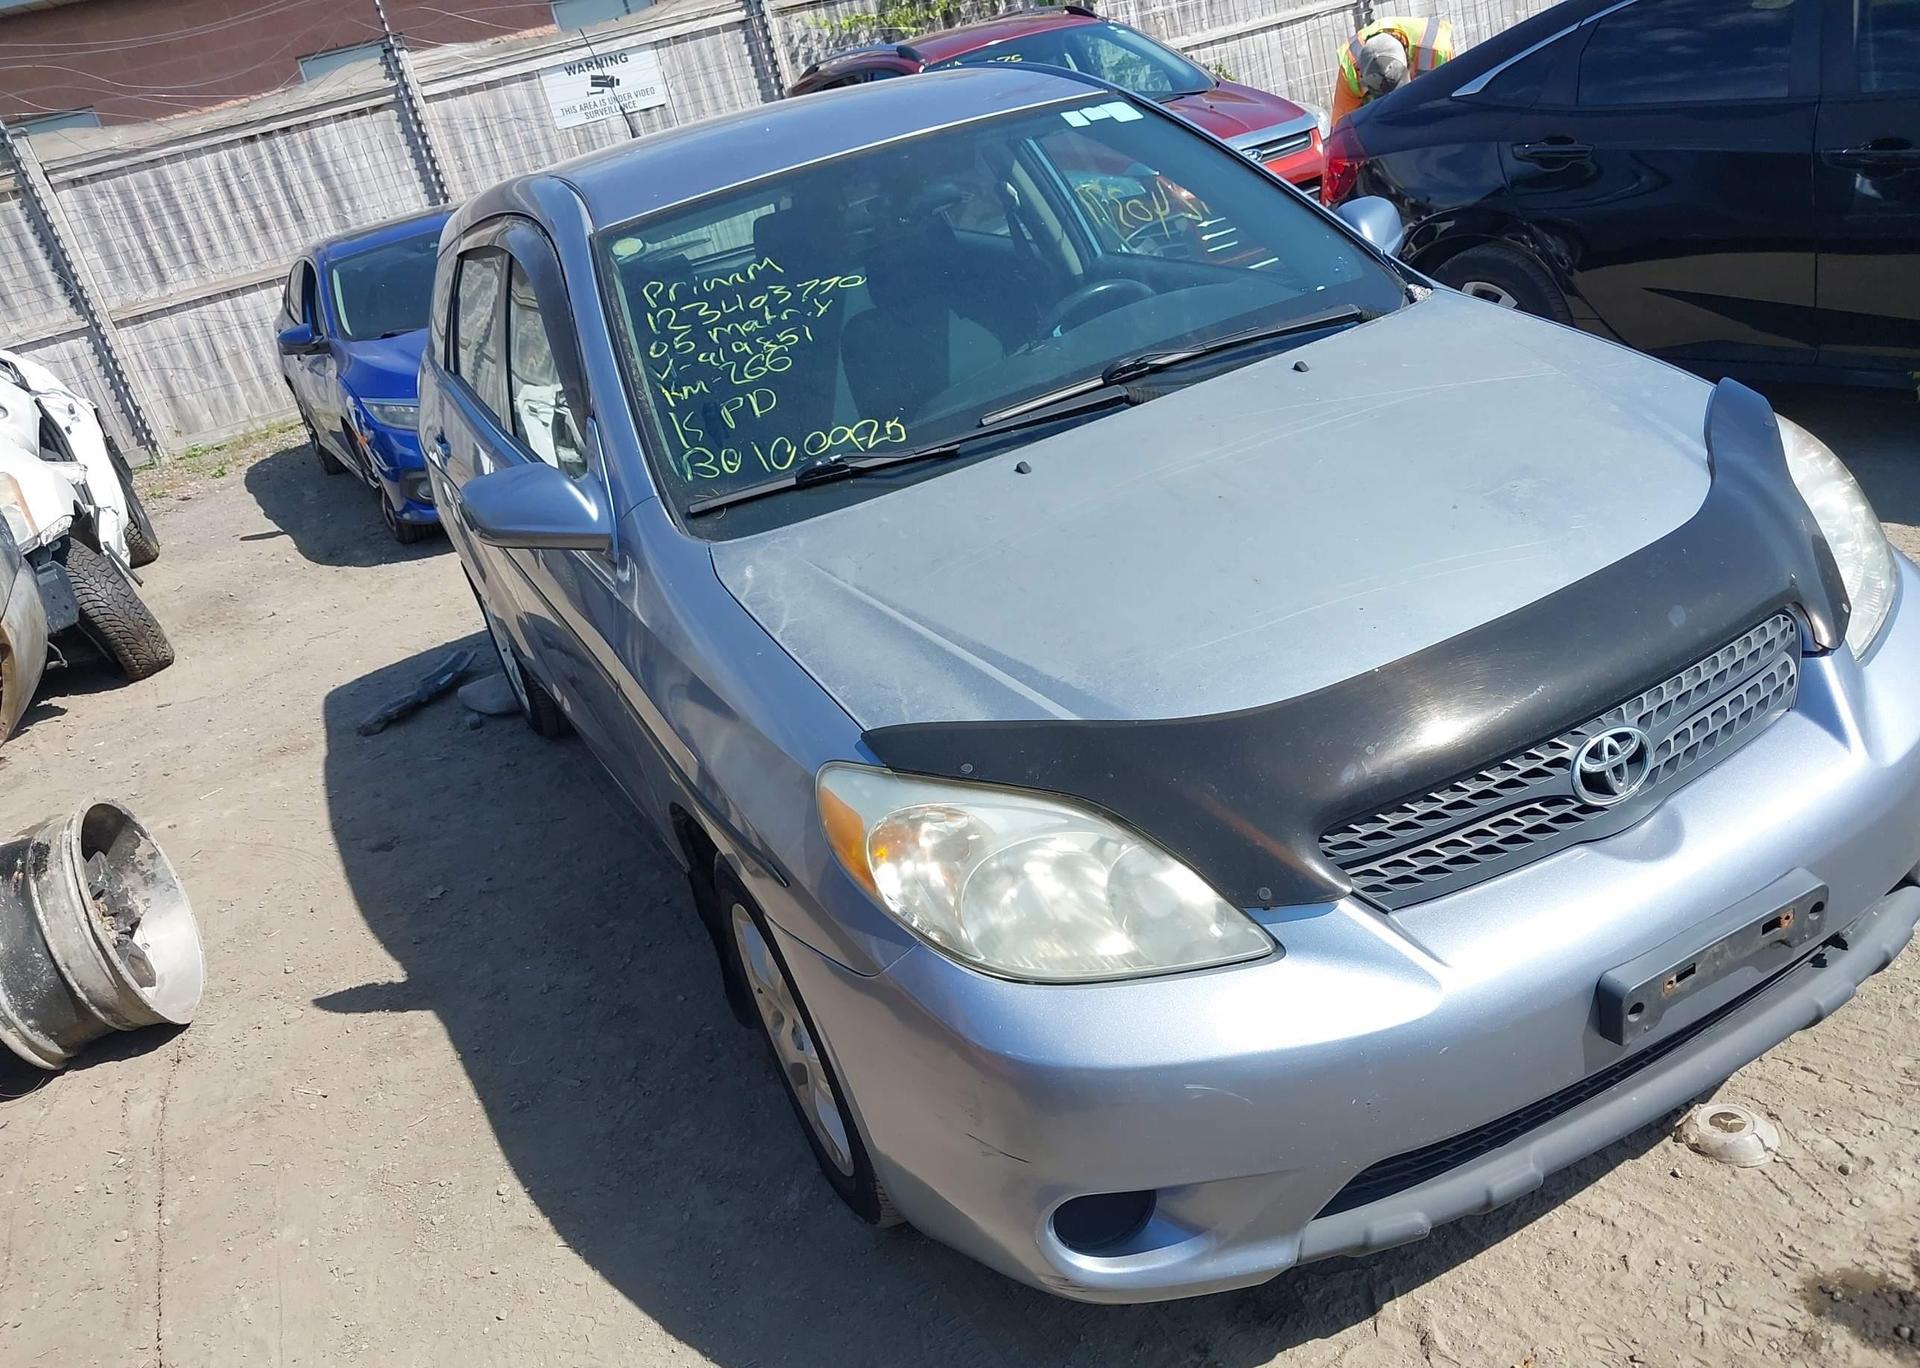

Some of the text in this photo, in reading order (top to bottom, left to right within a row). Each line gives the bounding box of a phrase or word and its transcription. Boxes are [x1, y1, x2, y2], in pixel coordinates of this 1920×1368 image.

[564, 53, 629, 76] WARNING
[560, 87, 656, 118] THIS AREA IS UNDER VIDEO
